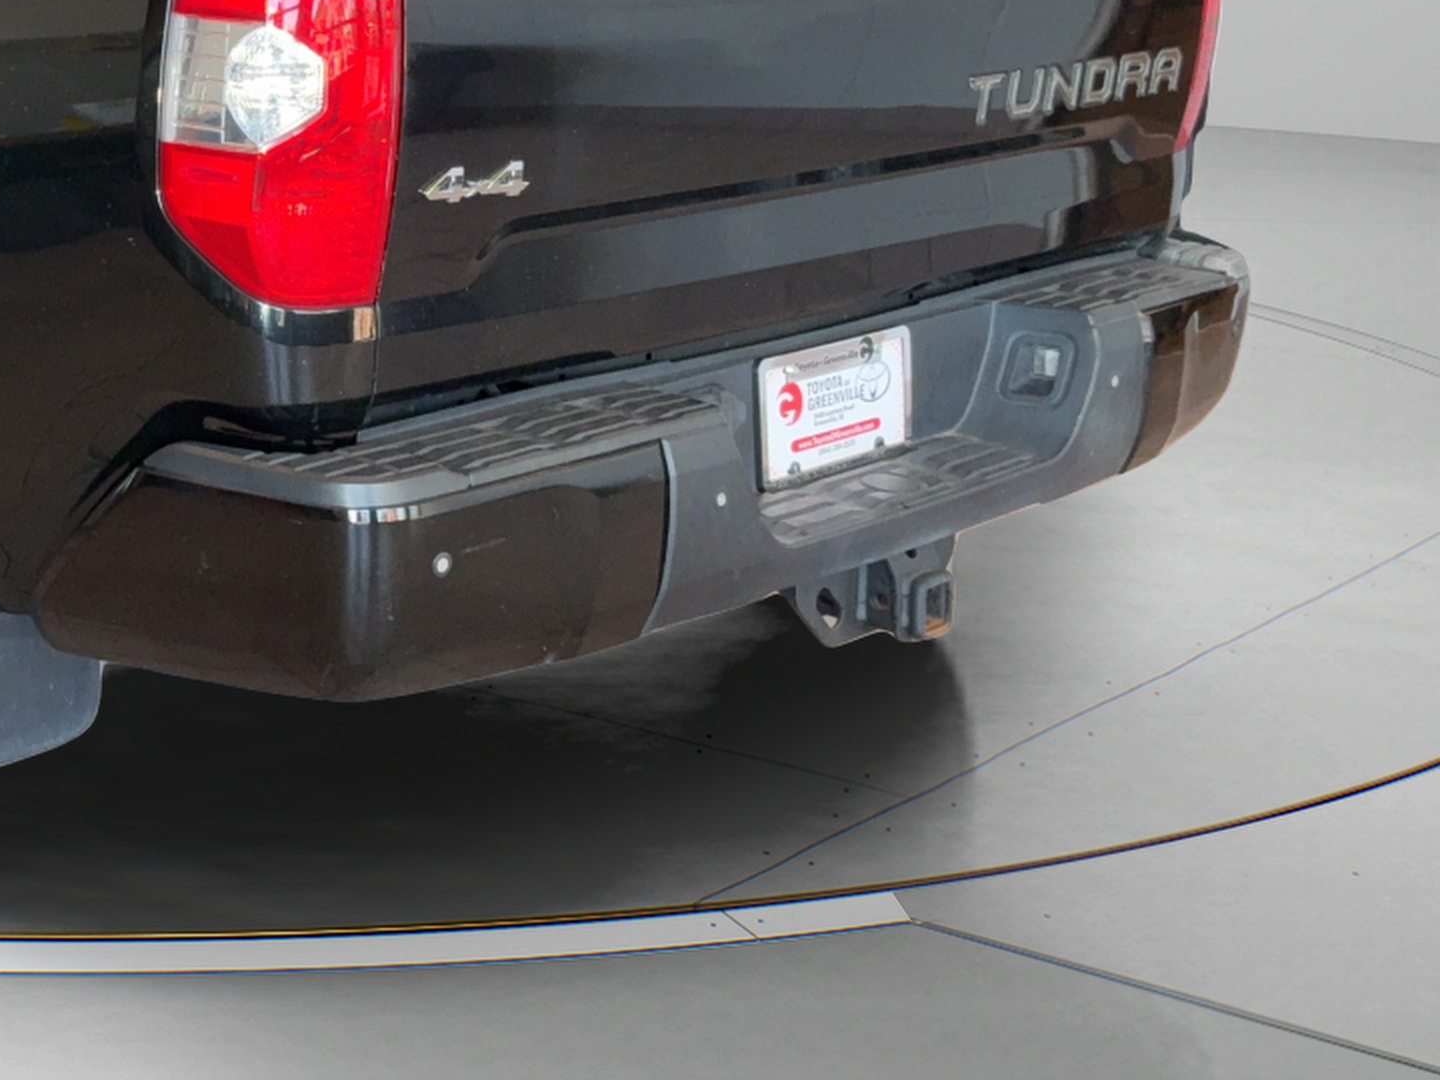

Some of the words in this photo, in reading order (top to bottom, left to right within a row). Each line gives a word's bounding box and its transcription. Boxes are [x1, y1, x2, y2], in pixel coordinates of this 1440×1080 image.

[968, 46, 1183, 126] TUNDRA
[807, 376, 843, 395] TOYOTA
[807, 384, 865, 411] GREENVILLE
